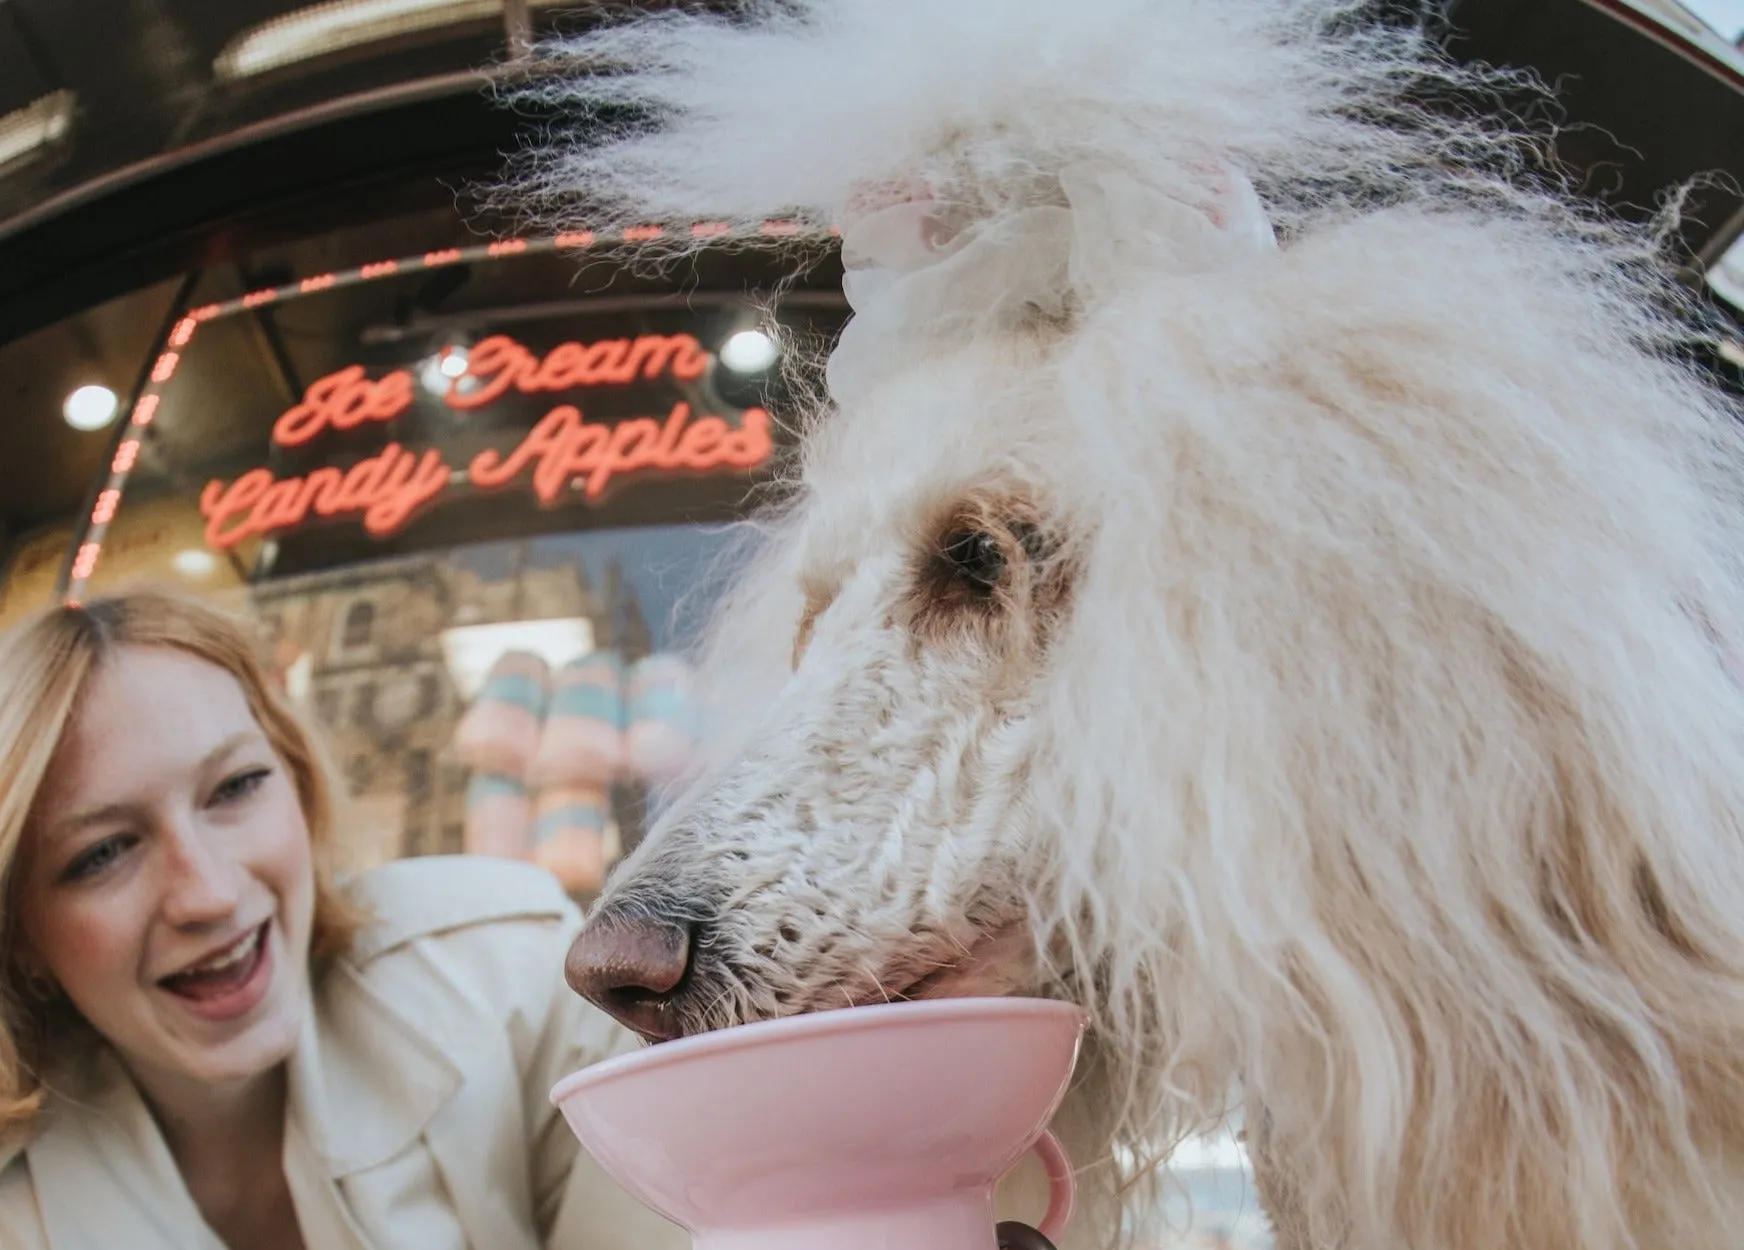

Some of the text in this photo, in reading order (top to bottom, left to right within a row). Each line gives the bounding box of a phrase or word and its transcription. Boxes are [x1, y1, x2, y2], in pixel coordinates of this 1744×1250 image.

[274, 333, 709, 444] Ice Cream
[201, 443, 451, 549] Candy
[468, 403, 774, 501] Apples
